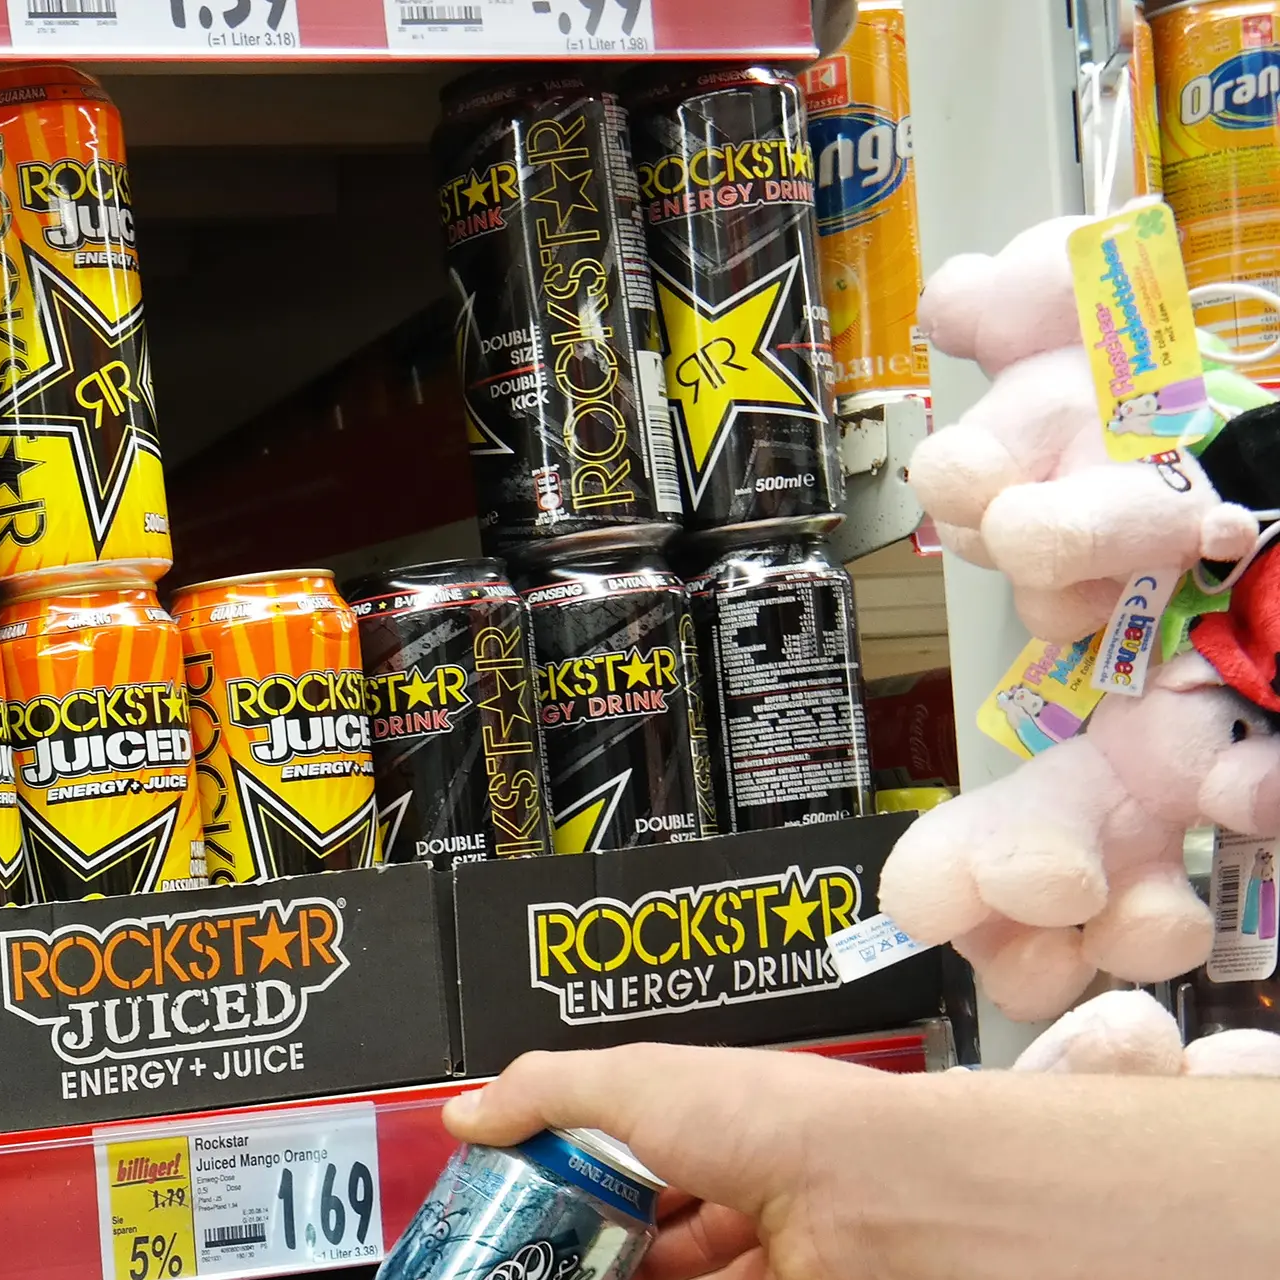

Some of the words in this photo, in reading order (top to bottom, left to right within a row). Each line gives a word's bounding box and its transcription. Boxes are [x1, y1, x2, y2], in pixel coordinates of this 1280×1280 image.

[233, 32, 261, 47] Liter
[619, 37, 648, 51] 1.98)
[481, 326, 542, 355] DOUBLE
[511, 343, 543, 366] SIZE
[490, 376, 548, 398] DOUBLE
[511, 390, 550, 413] KICK
[529, 583, 583, 603] GINSENG
[23, 730, 190, 780] JUICED
[47, 778, 131, 802] ENERGY
[635, 813, 695, 833] DOUBLE
[416, 833, 485, 855] DOUBLE
[566, 960, 714, 1013] ENERGY
[734, 948, 837, 990] DRINK
[59, 980, 297, 1051] JUICED
[61, 1057, 183, 1100] ENERGY
[214, 1043, 305, 1080] JUICE
[195, 1134, 249, 1151] Rockstar
[116, 1152, 181, 1185] billiger!
[196, 1157, 236, 1172] Juiced
[240, 1152, 280, 1168] Mango
[284, 1148, 328, 1164] Orange
[278, 1161, 373, 1250] 1.69
[112, 1216, 124, 1225] Sie
[113, 1225, 138, 1236] sparen
